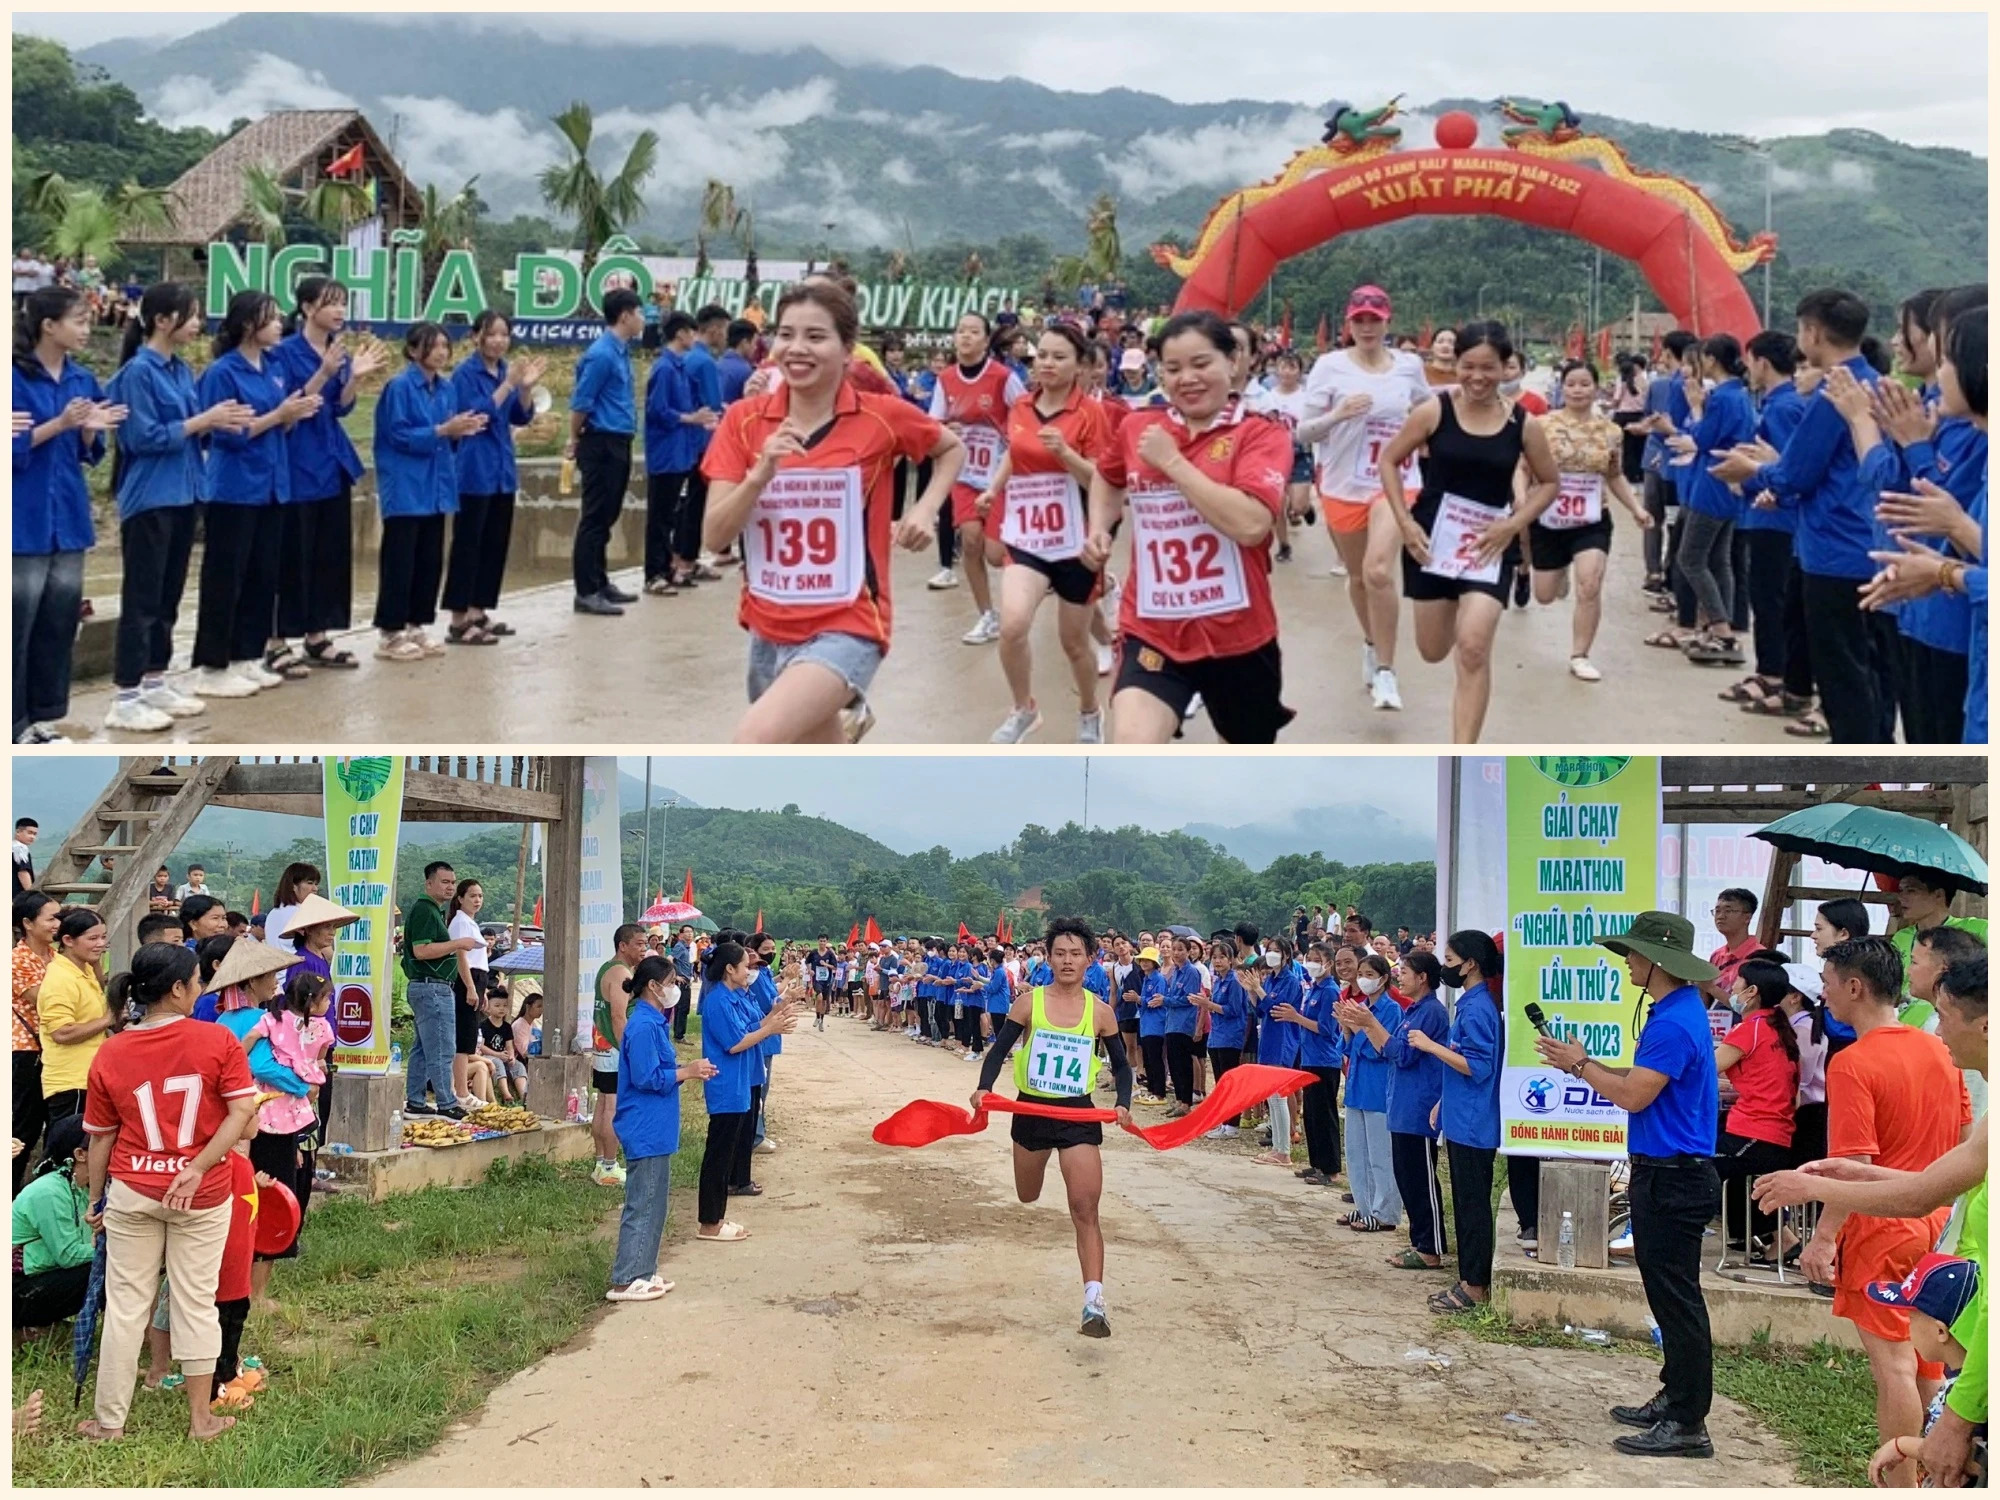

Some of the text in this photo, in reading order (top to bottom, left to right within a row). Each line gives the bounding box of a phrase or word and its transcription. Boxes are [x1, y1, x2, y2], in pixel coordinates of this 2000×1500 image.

[1362, 171, 1535, 210] XUẤT PHÁT
[206, 229, 488, 324] NGHĨA
[504, 234, 655, 320] ĐÔ
[968, 445, 991, 468] 10
[1016, 502, 1065, 534] 140
[1556, 494, 1587, 517] 30
[756, 517, 837, 567] 139
[1147, 533, 1224, 585] 132
[796, 574, 833, 591] 5KM
[1190, 584, 1224, 605] 5KM
[1555, 762, 1606, 773] MARATHON
[1544, 791, 1619, 845] GIẢI CHẠY
[1540, 859, 1623, 892] MARATHON
[1572, 906, 1594, 946] ĐÔ
[1599, 914, 1637, 937] XAN
[1542, 957, 1620, 1002] LẦN THỨ 2
[1583, 1023, 1620, 1057] 2023
[1036, 1052, 1082, 1082] 114
[1039, 1080, 1047, 1089] LY
[1049, 1082, 1067, 1093] 10KM
[1068, 1085, 1083, 1096] NAM
[133, 1073, 203, 1152] 17
[1510, 1122, 1624, 1144] ĐỒNG HÀNH CÙNG GIẢI
[131, 1155, 191, 1172] VietG
